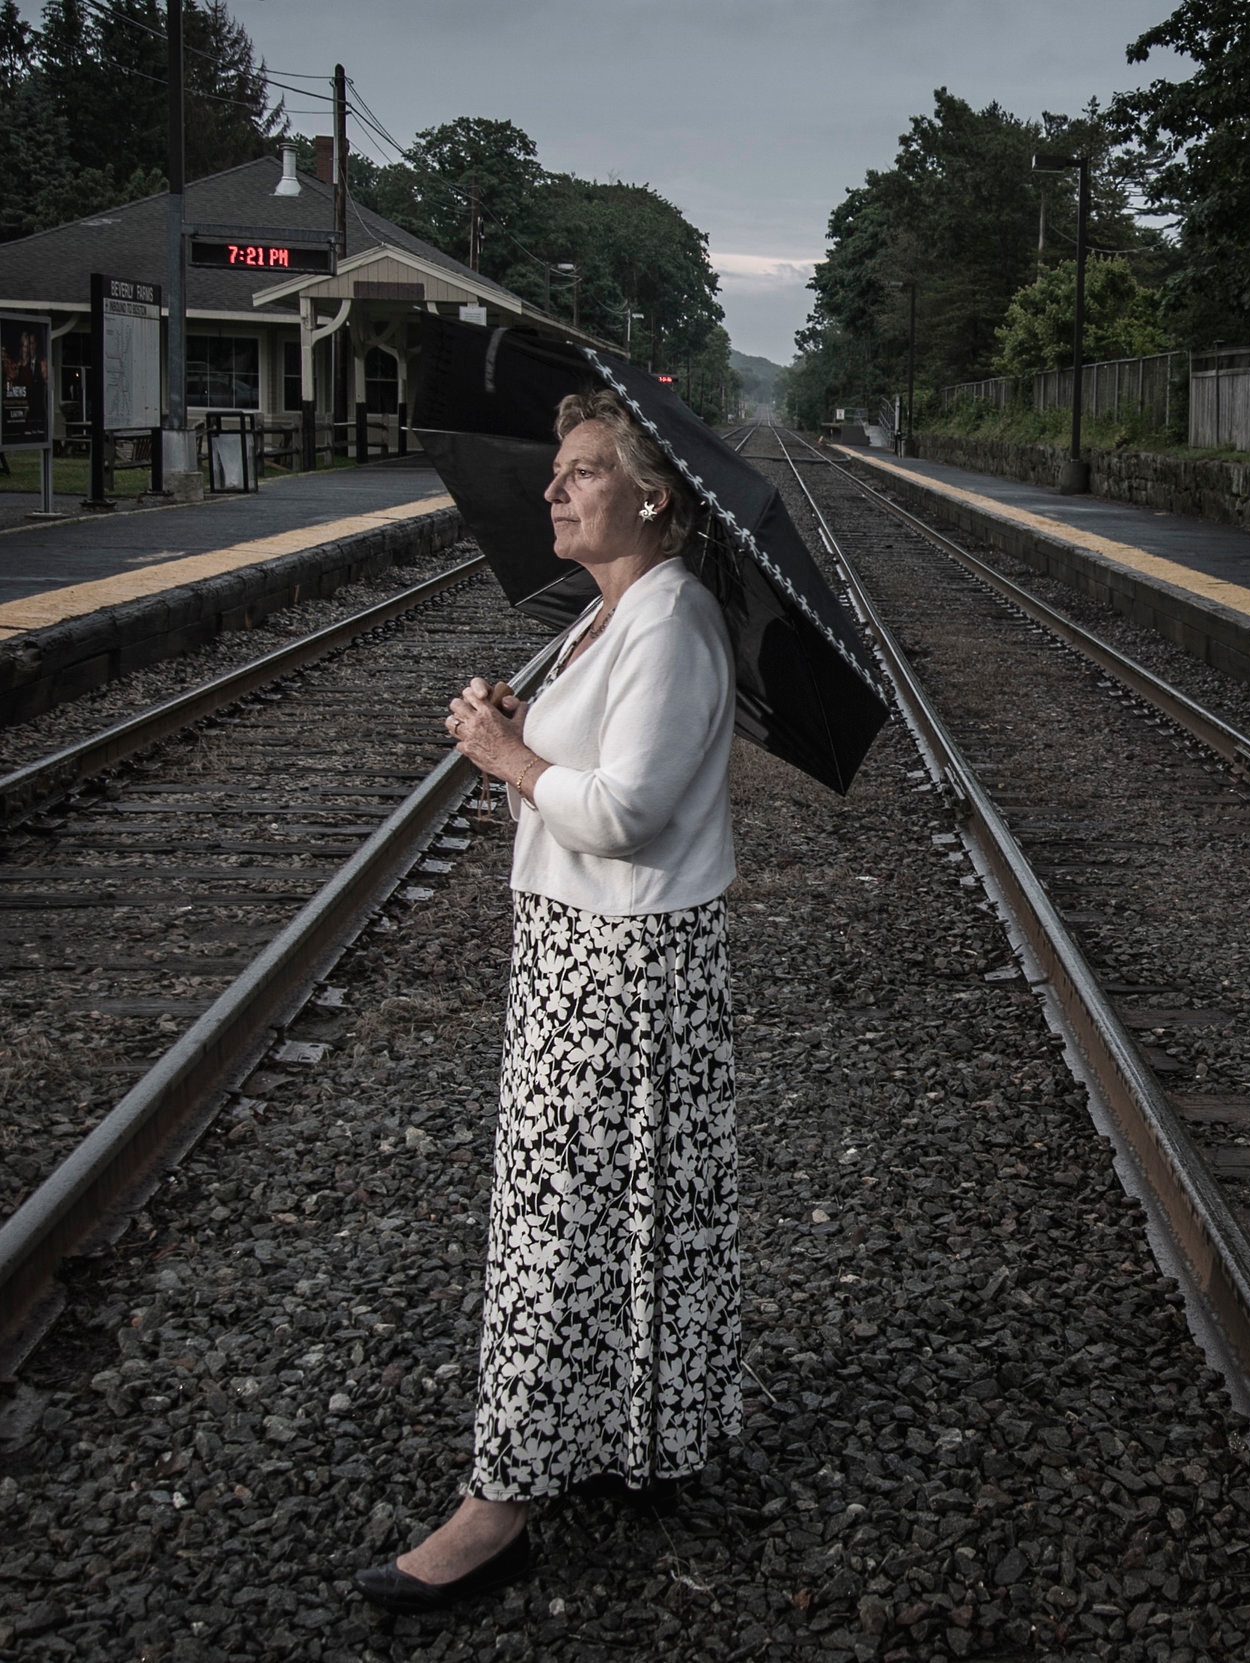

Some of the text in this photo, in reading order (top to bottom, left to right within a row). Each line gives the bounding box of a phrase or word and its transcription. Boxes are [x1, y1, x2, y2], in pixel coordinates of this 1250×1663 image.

[227, 244, 289, 268] 7:21 PM
[111, 279, 154, 304] BEVERLY FARMS
[110, 300, 127, 314] INBOUND
[133, 303, 147, 316] BOSTON
